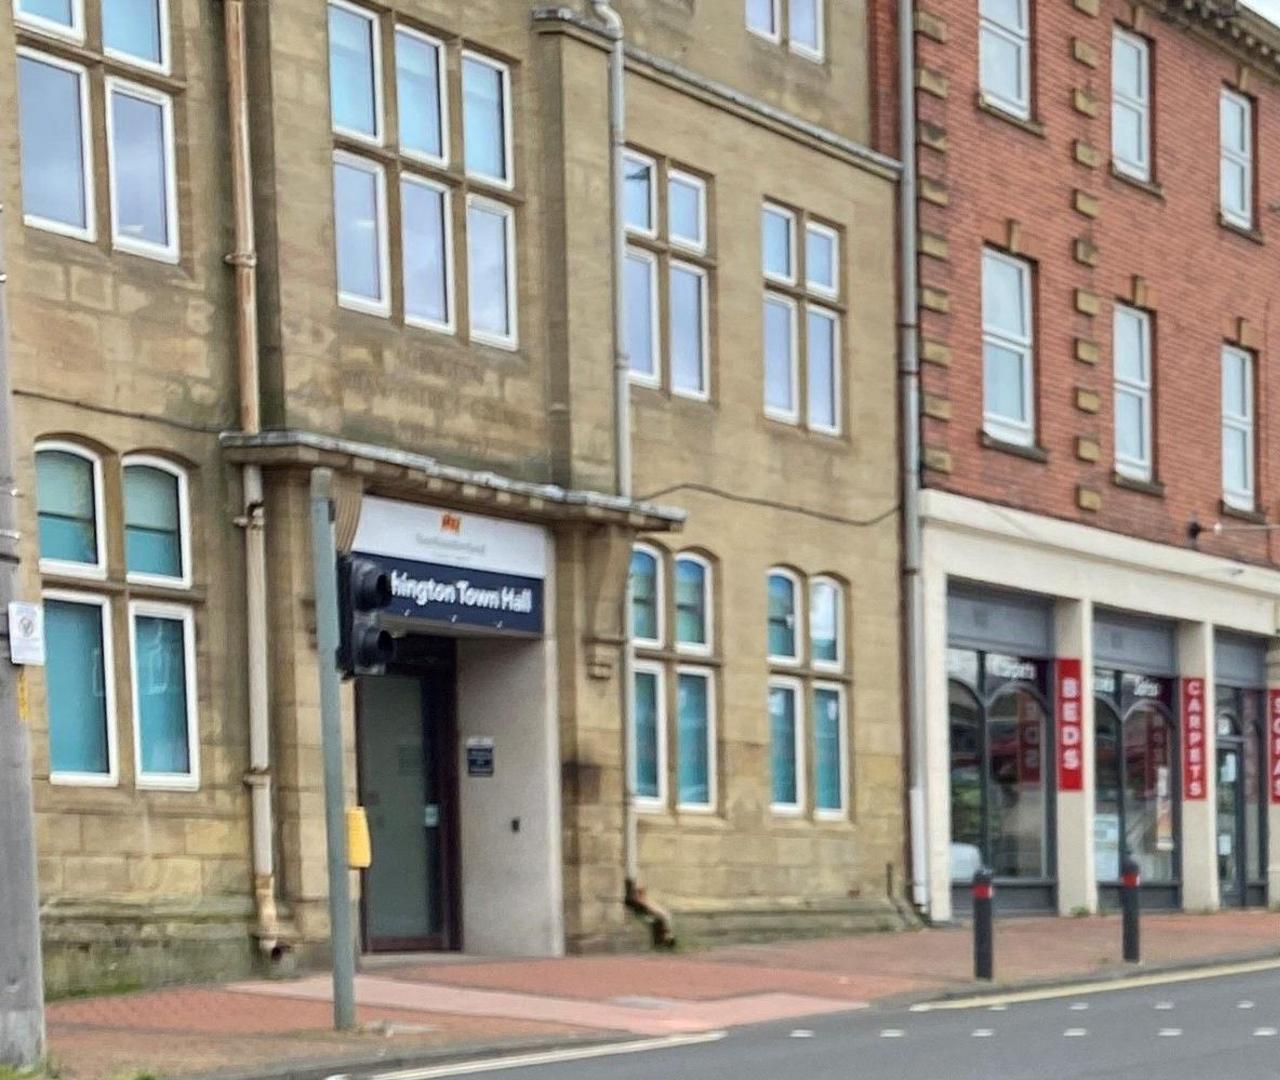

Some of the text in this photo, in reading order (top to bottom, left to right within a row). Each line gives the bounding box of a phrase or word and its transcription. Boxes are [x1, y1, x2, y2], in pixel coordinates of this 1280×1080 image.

[390, 569, 533, 614] hington Town Hall
[1061, 677, 1081, 771] BEDS
[1187, 680, 1203, 797] CARPETS
